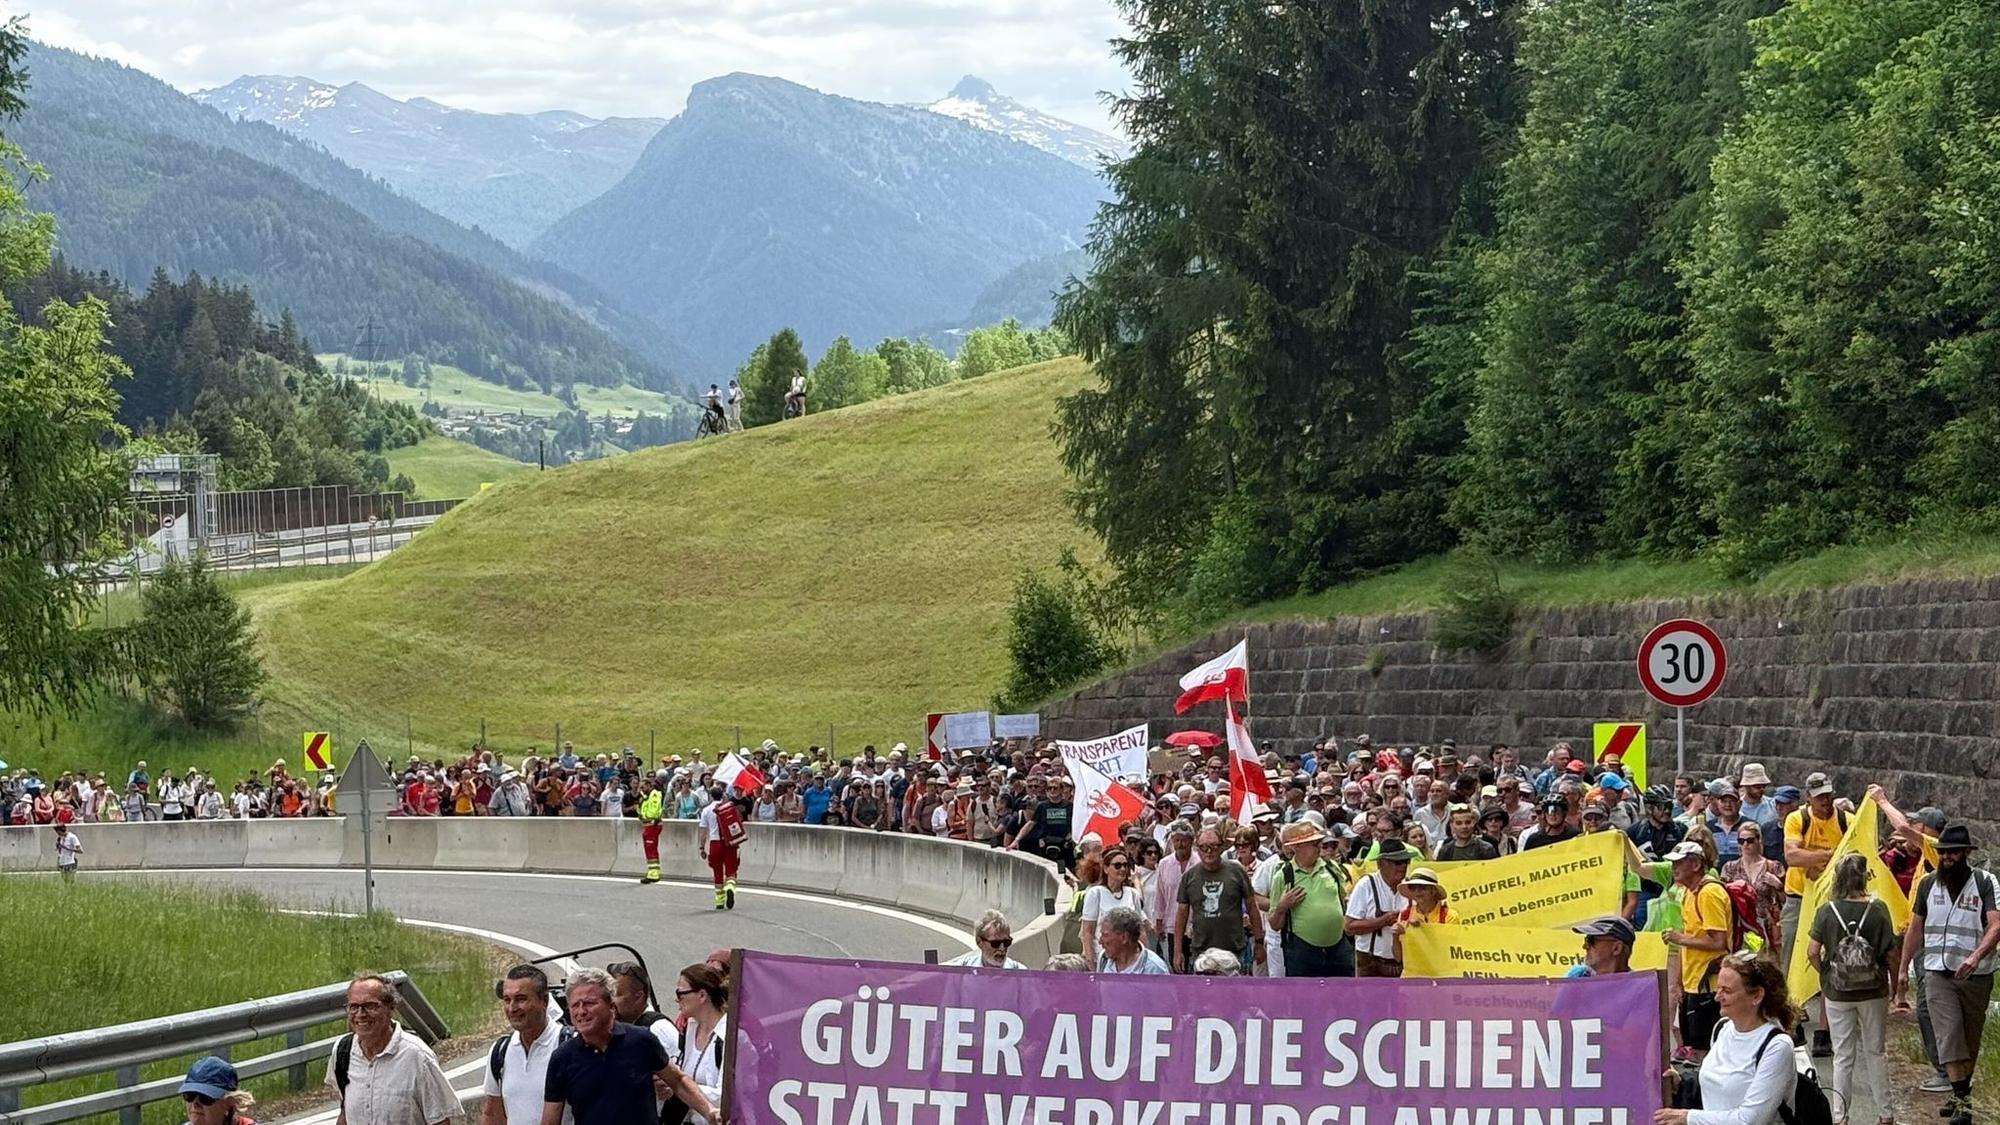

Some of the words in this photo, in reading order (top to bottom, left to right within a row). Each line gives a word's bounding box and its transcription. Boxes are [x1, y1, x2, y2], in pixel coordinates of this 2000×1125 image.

[1660, 643, 1705, 684] 30
[1089, 756, 1121, 775] TATT
[1450, 875, 1526, 902] STAUFREI,
[1528, 855, 1604, 883] MAUTFREI
[1461, 910, 1496, 926] eren
[1499, 886, 1594, 917] Lebensraum
[1449, 945, 1512, 963] Mensch
[1516, 952, 1541, 964] vor
[1545, 951, 1585, 966] Verk
[800, 985, 1024, 1077] GÜTER
[1040, 1013, 1174, 1082] AUF
[1194, 1017, 1303, 1087] DIE
[1322, 1018, 1602, 1088] SCHIENE
[768, 1079, 968, 1125] STATT
